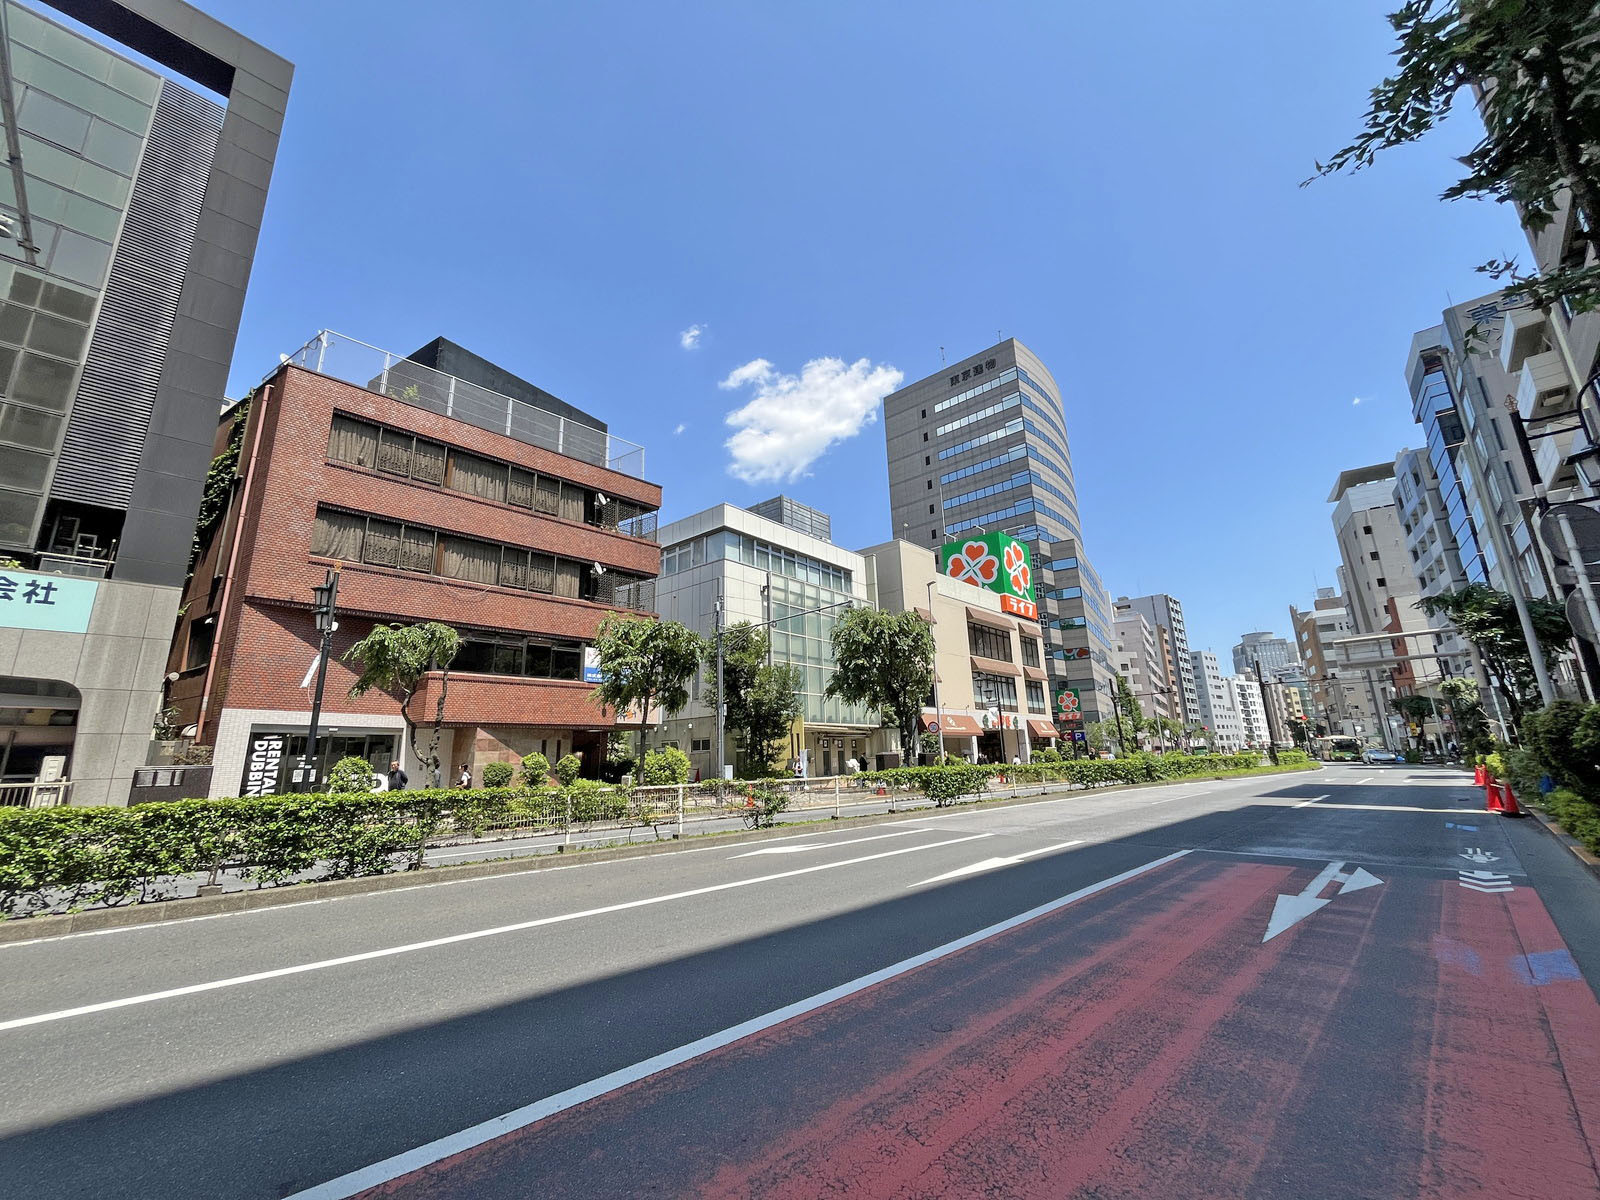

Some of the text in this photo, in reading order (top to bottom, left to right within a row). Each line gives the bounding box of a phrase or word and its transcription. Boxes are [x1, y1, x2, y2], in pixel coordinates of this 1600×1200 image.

[950, 358, 997, 387] 東京建物
[1010, 597, 1034, 616] ライフ
[1075, 732, 1082, 740] P
[261, 741, 283, 796] RENTAL
